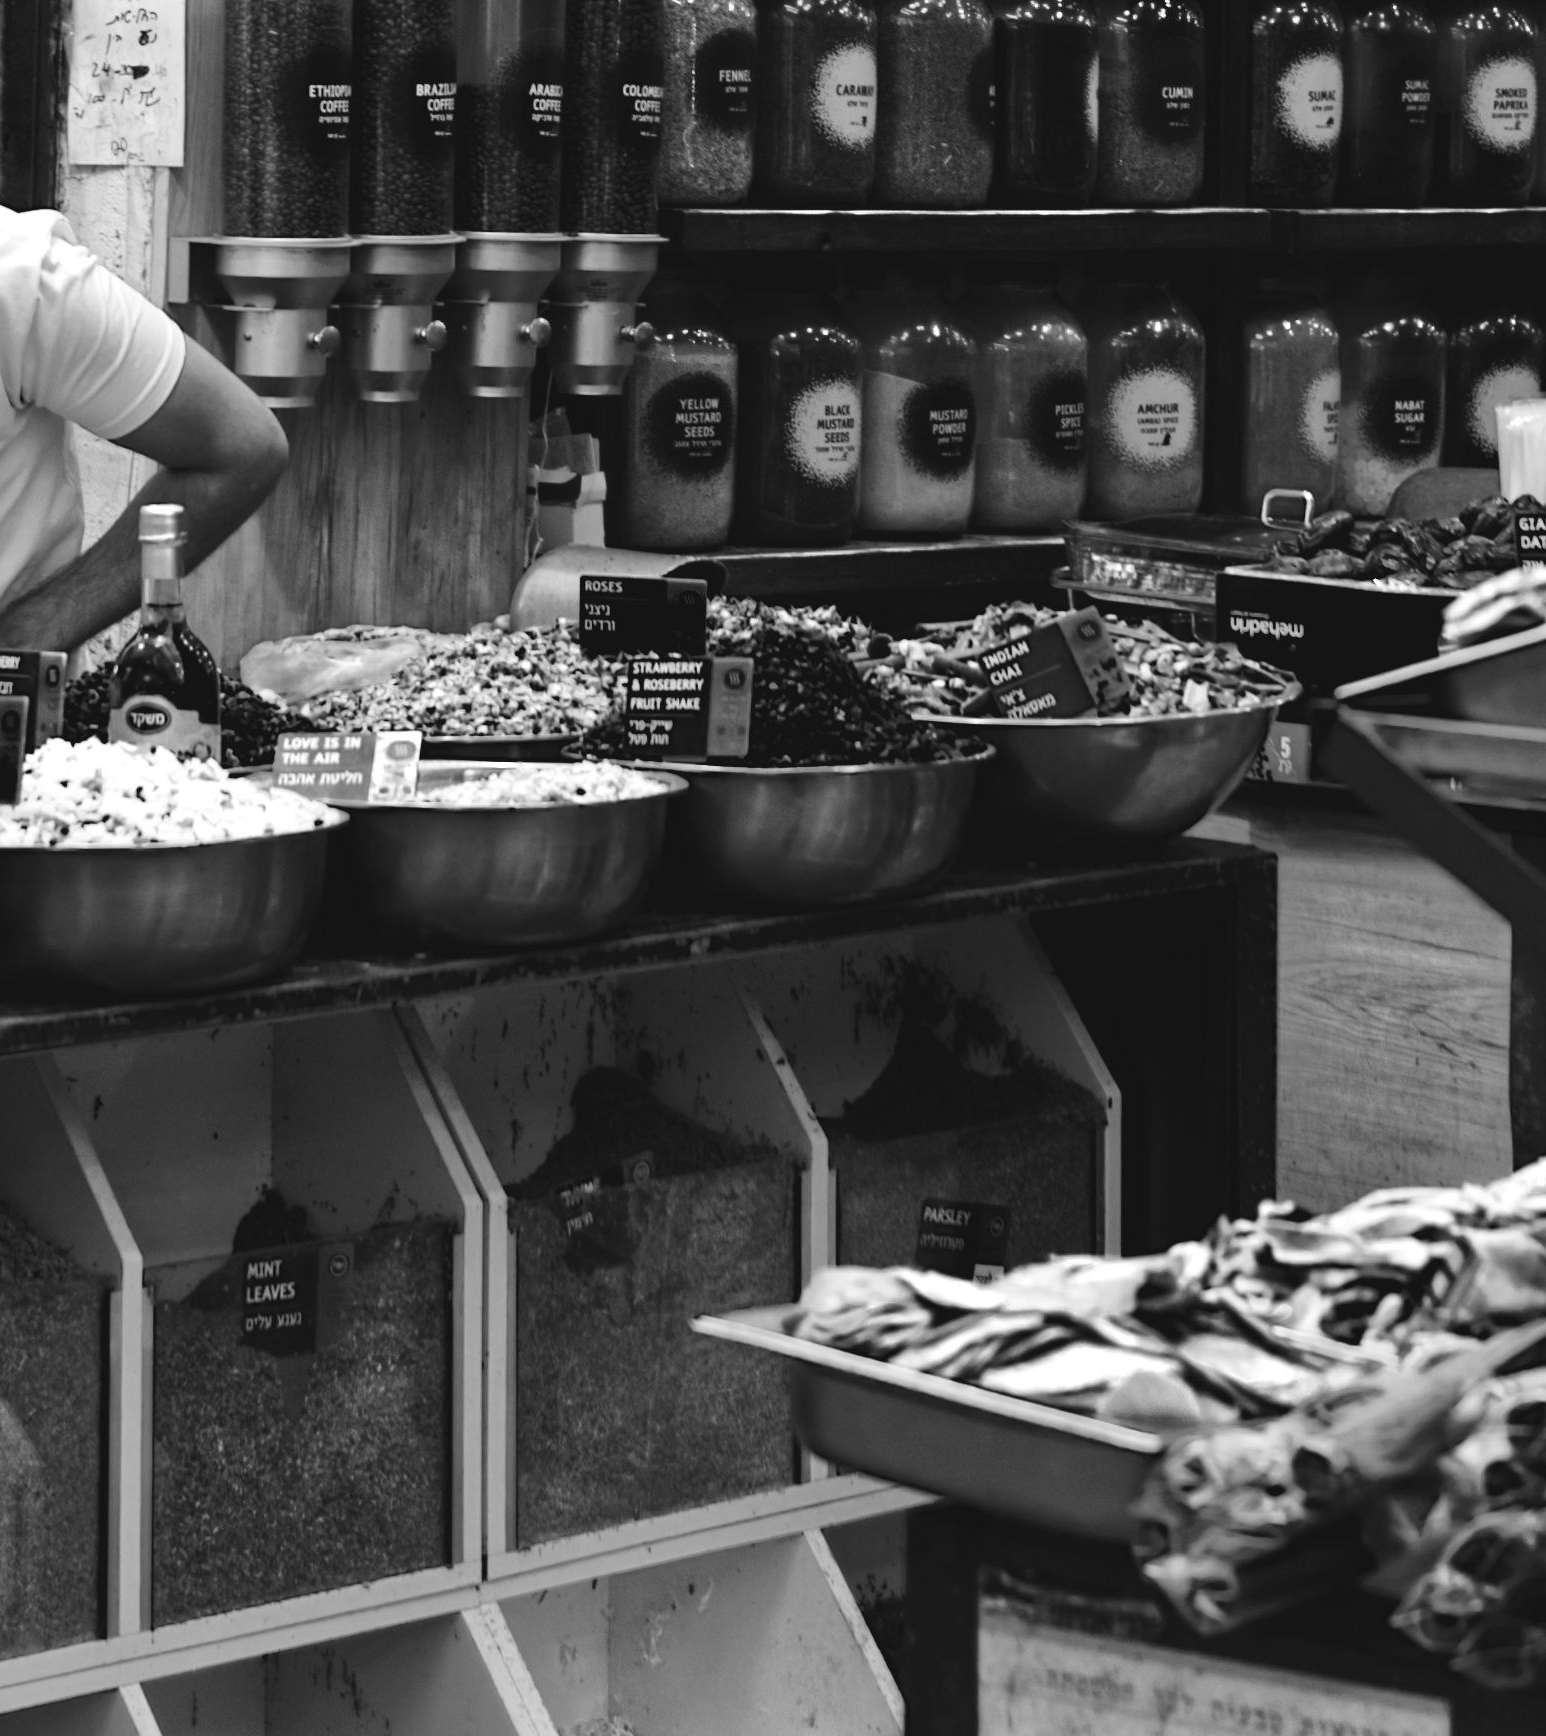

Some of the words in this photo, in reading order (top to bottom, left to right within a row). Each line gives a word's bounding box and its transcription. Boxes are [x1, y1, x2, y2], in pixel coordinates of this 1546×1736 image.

[718, 69, 752, 83] FENNEL
[1161, 86, 1194, 99] CUMIN
[1308, 89, 1336, 102] SUMAC
[1495, 88, 1529, 99] SMOKED
[319, 99, 350, 113] COFFEE
[532, 98, 562, 112] COFFEE
[1493, 99, 1529, 111] PAPRIKA
[679, 397, 720, 411] YELLOW
[824, 404, 851, 417] BLACK
[1137, 401, 1180, 415] AMCHUR
[1394, 399, 1425, 411] NABAT
[674, 411, 723, 425] MUSTARD
[929, 408, 968, 422] MUSTARD
[1394, 411, 1425, 424] SUGAR
[931, 422, 967, 436] POWDER
[1060, 416, 1082, 429] SPICE
[683, 425, 716, 439] SEEDS
[824, 431, 851, 444] SEEDS
[583, 579, 624, 595] ROSES
[1229, 615, 1305, 640] mehadrin
[981, 640, 1030, 671] INDIAN
[632, 660, 704, 675] STRAWBERRY
[989, 661, 1024, 687] CHAI
[643, 676, 705, 692] ROSEBERRY
[629, 696, 663, 712] FRUIT
[665, 696, 701, 712] SHAKE
[282, 735, 321, 751] LOVE
[323, 736, 340, 750] IS
[343, 735, 363, 750] IN
[1279, 734, 1293, 760] 5
[281, 751, 310, 766] THE
[312, 751, 341, 766] AIR
[922, 1205, 973, 1226] PARSLEY
[246, 1258, 284, 1281] MINT
[245, 1281, 296, 1305] LEAVES
